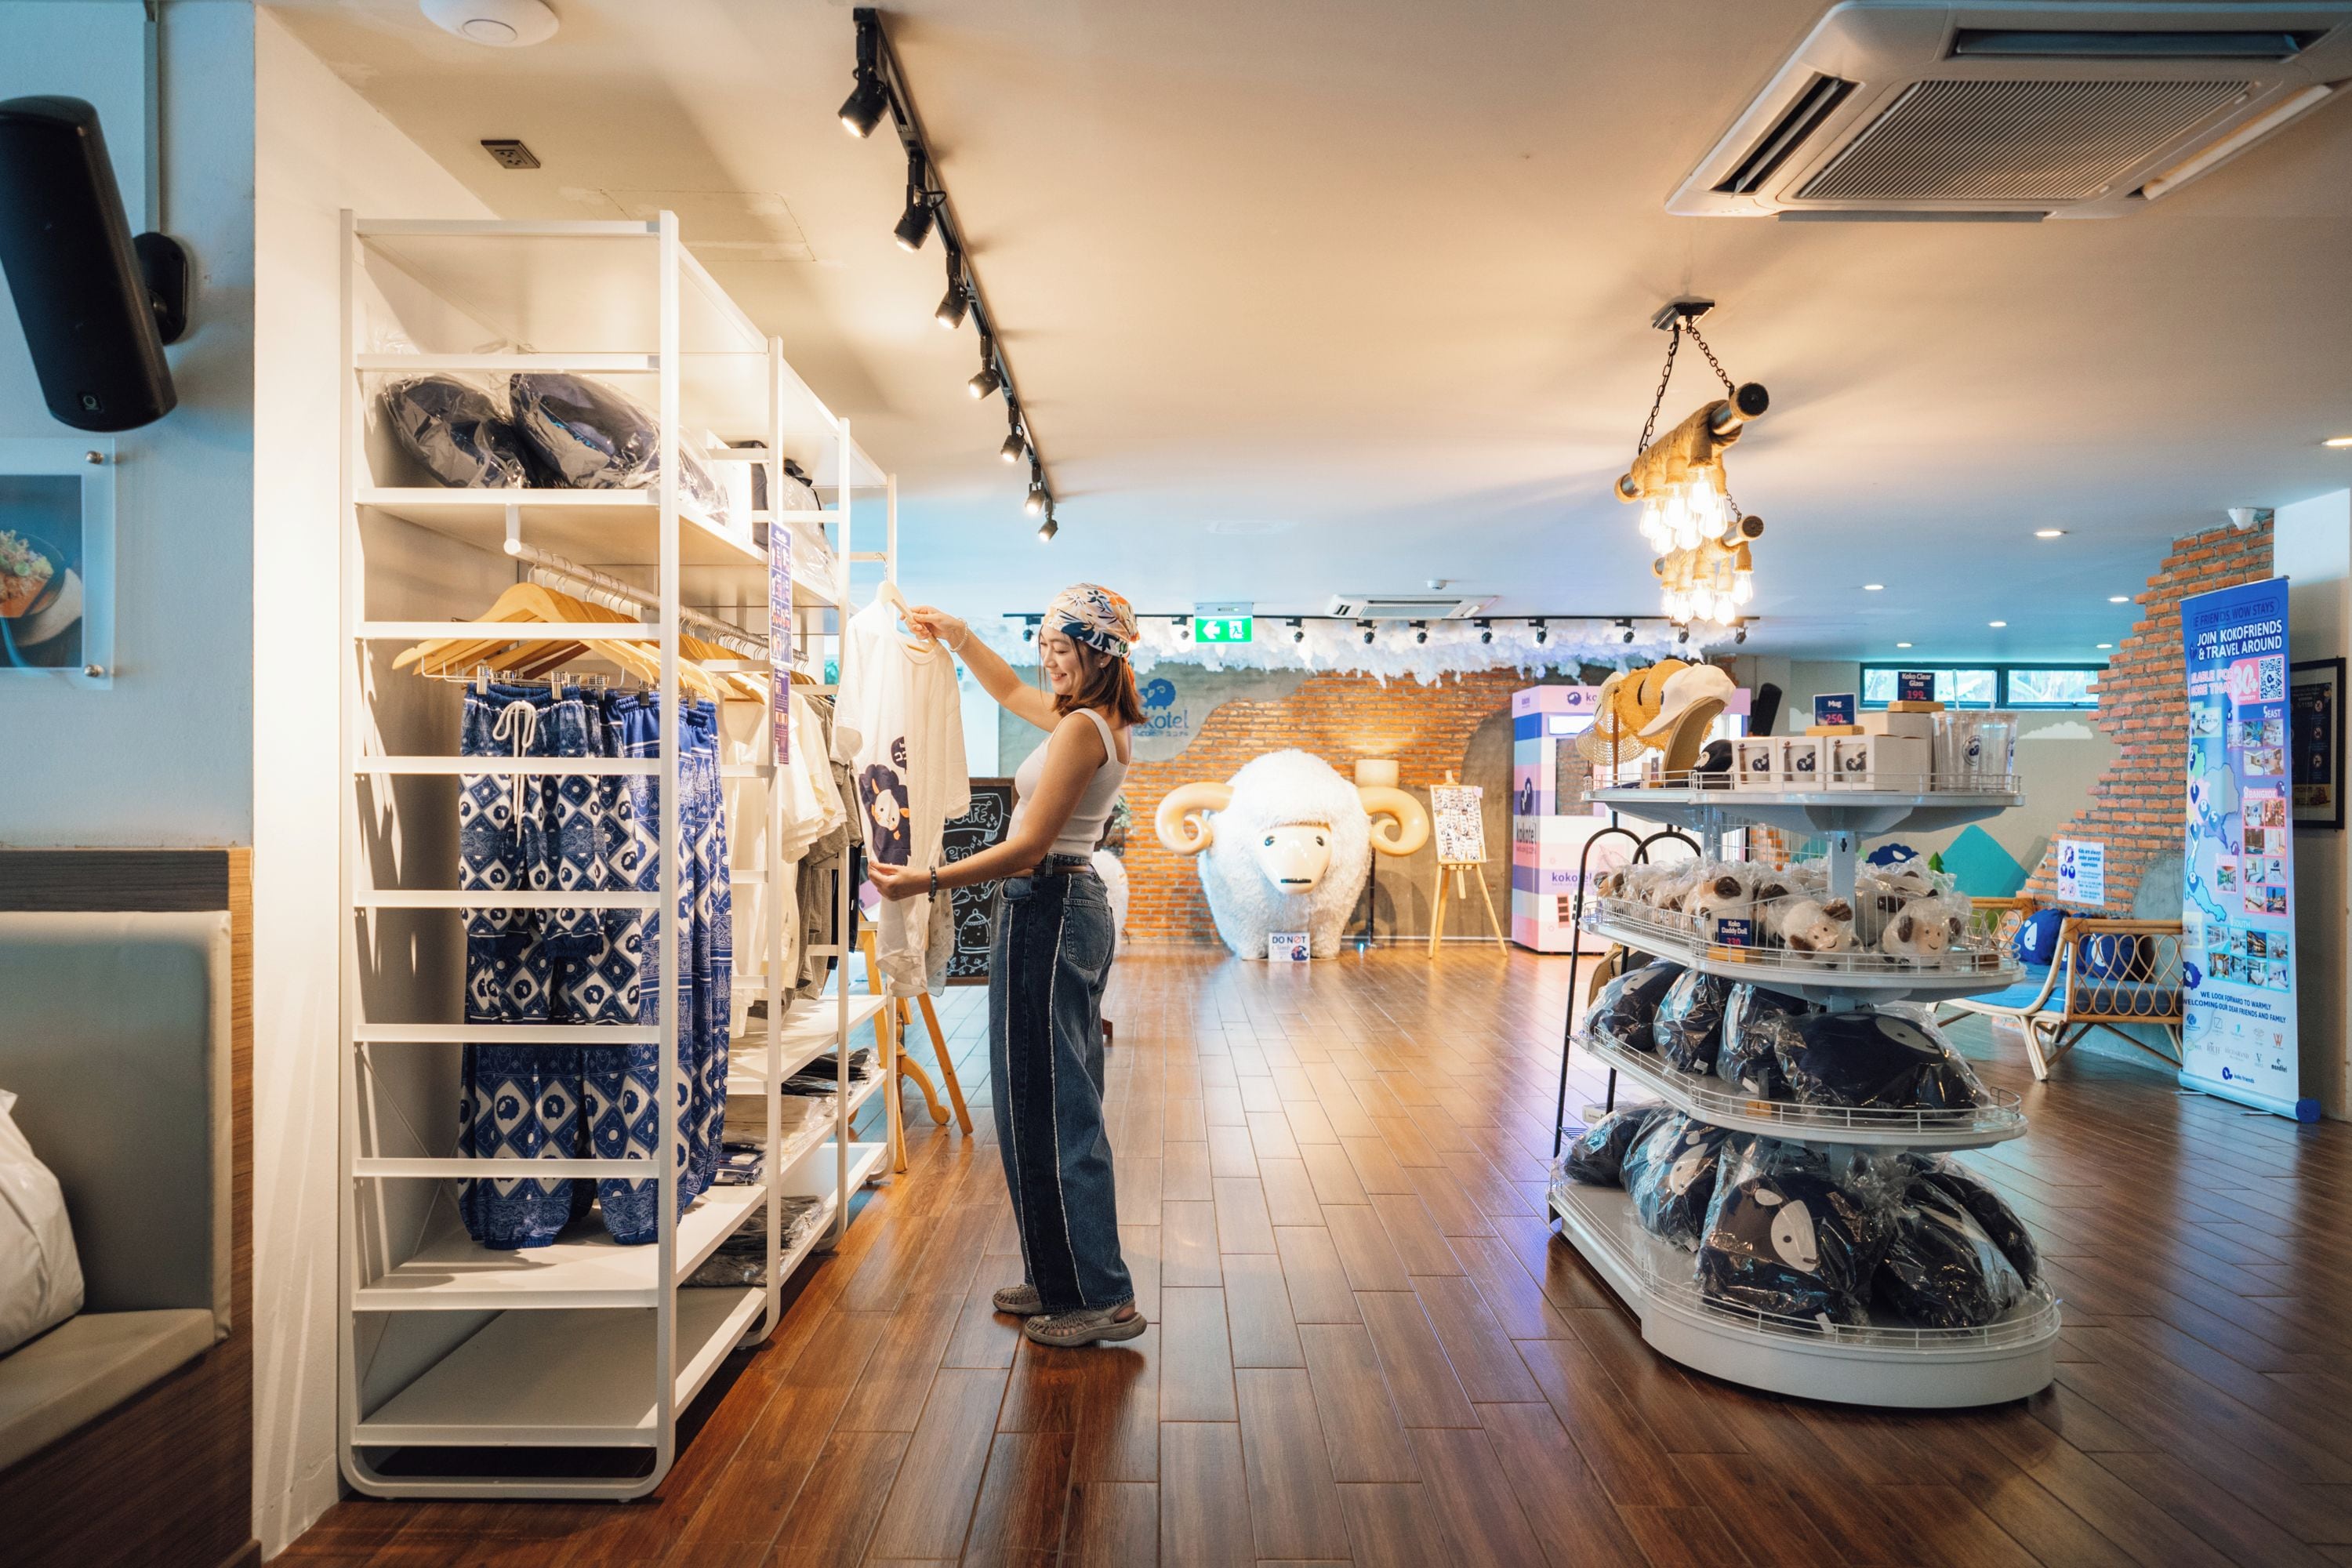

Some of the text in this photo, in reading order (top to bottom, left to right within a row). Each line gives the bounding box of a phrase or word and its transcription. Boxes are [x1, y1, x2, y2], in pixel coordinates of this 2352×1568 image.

[2252, 601, 2274, 616] STAYS
[2198, 619, 2282, 647] JOIN KOKOFRIENDS
[2198, 635, 2282, 660] & TRAVEL AROUND
[1907, 690, 1924, 700] 199
[1828, 700, 1842, 709] Mug
[1826, 713, 1843, 724] 250
[1516, 822, 1537, 844] kokotel
[1552, 872, 1592, 882] kokoel
[1721, 927, 1737, 935] Daddy
[2224, 995, 2244, 1005] FORWARD
[2251, 1000, 2271, 1011] WARMLY
[2183, 998, 2218, 1009] WELCOMING
[2228, 1005, 2239, 1014] DEAR
[2238, 1007, 2258, 1018] FRIENDS
[2269, 1014, 2286, 1024] FAMILY
